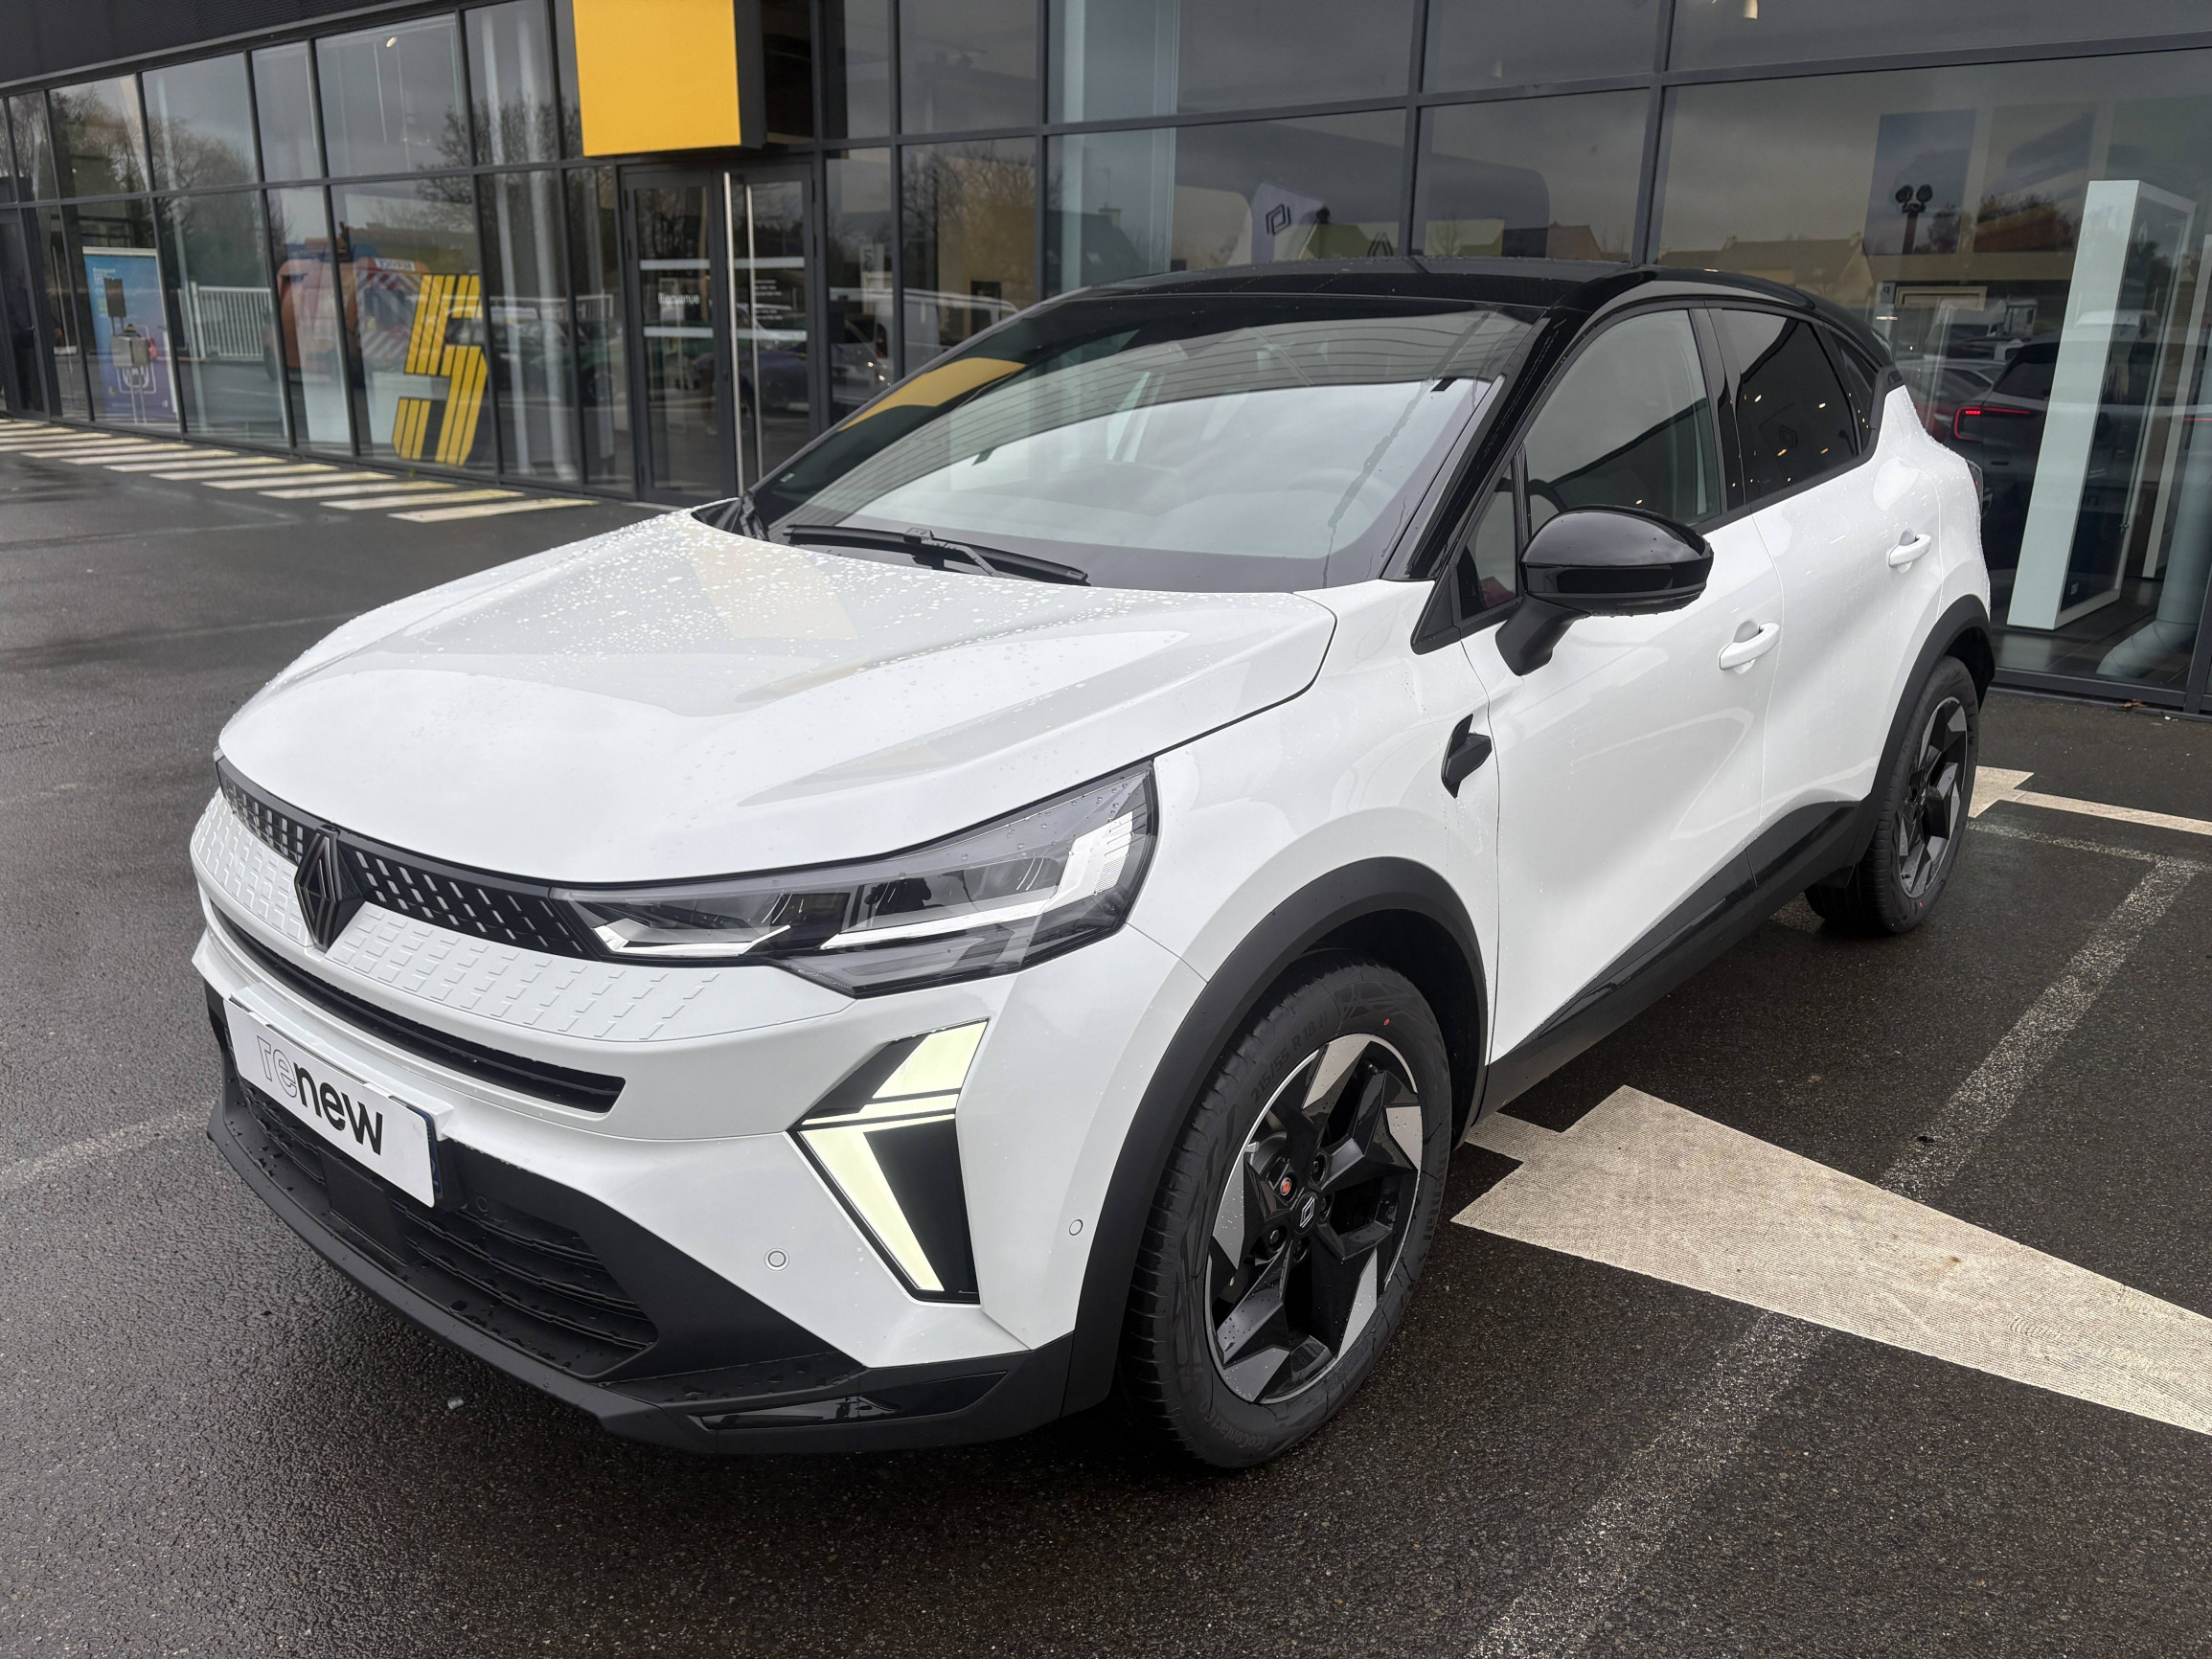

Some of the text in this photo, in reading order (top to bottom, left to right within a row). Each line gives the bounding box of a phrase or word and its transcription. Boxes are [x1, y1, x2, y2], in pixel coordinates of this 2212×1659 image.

[257, 1034, 383, 1155] renew
[1251, 1048, 1290, 1103] 215/55
[1211, 1416, 1268, 1450] EcoContact
